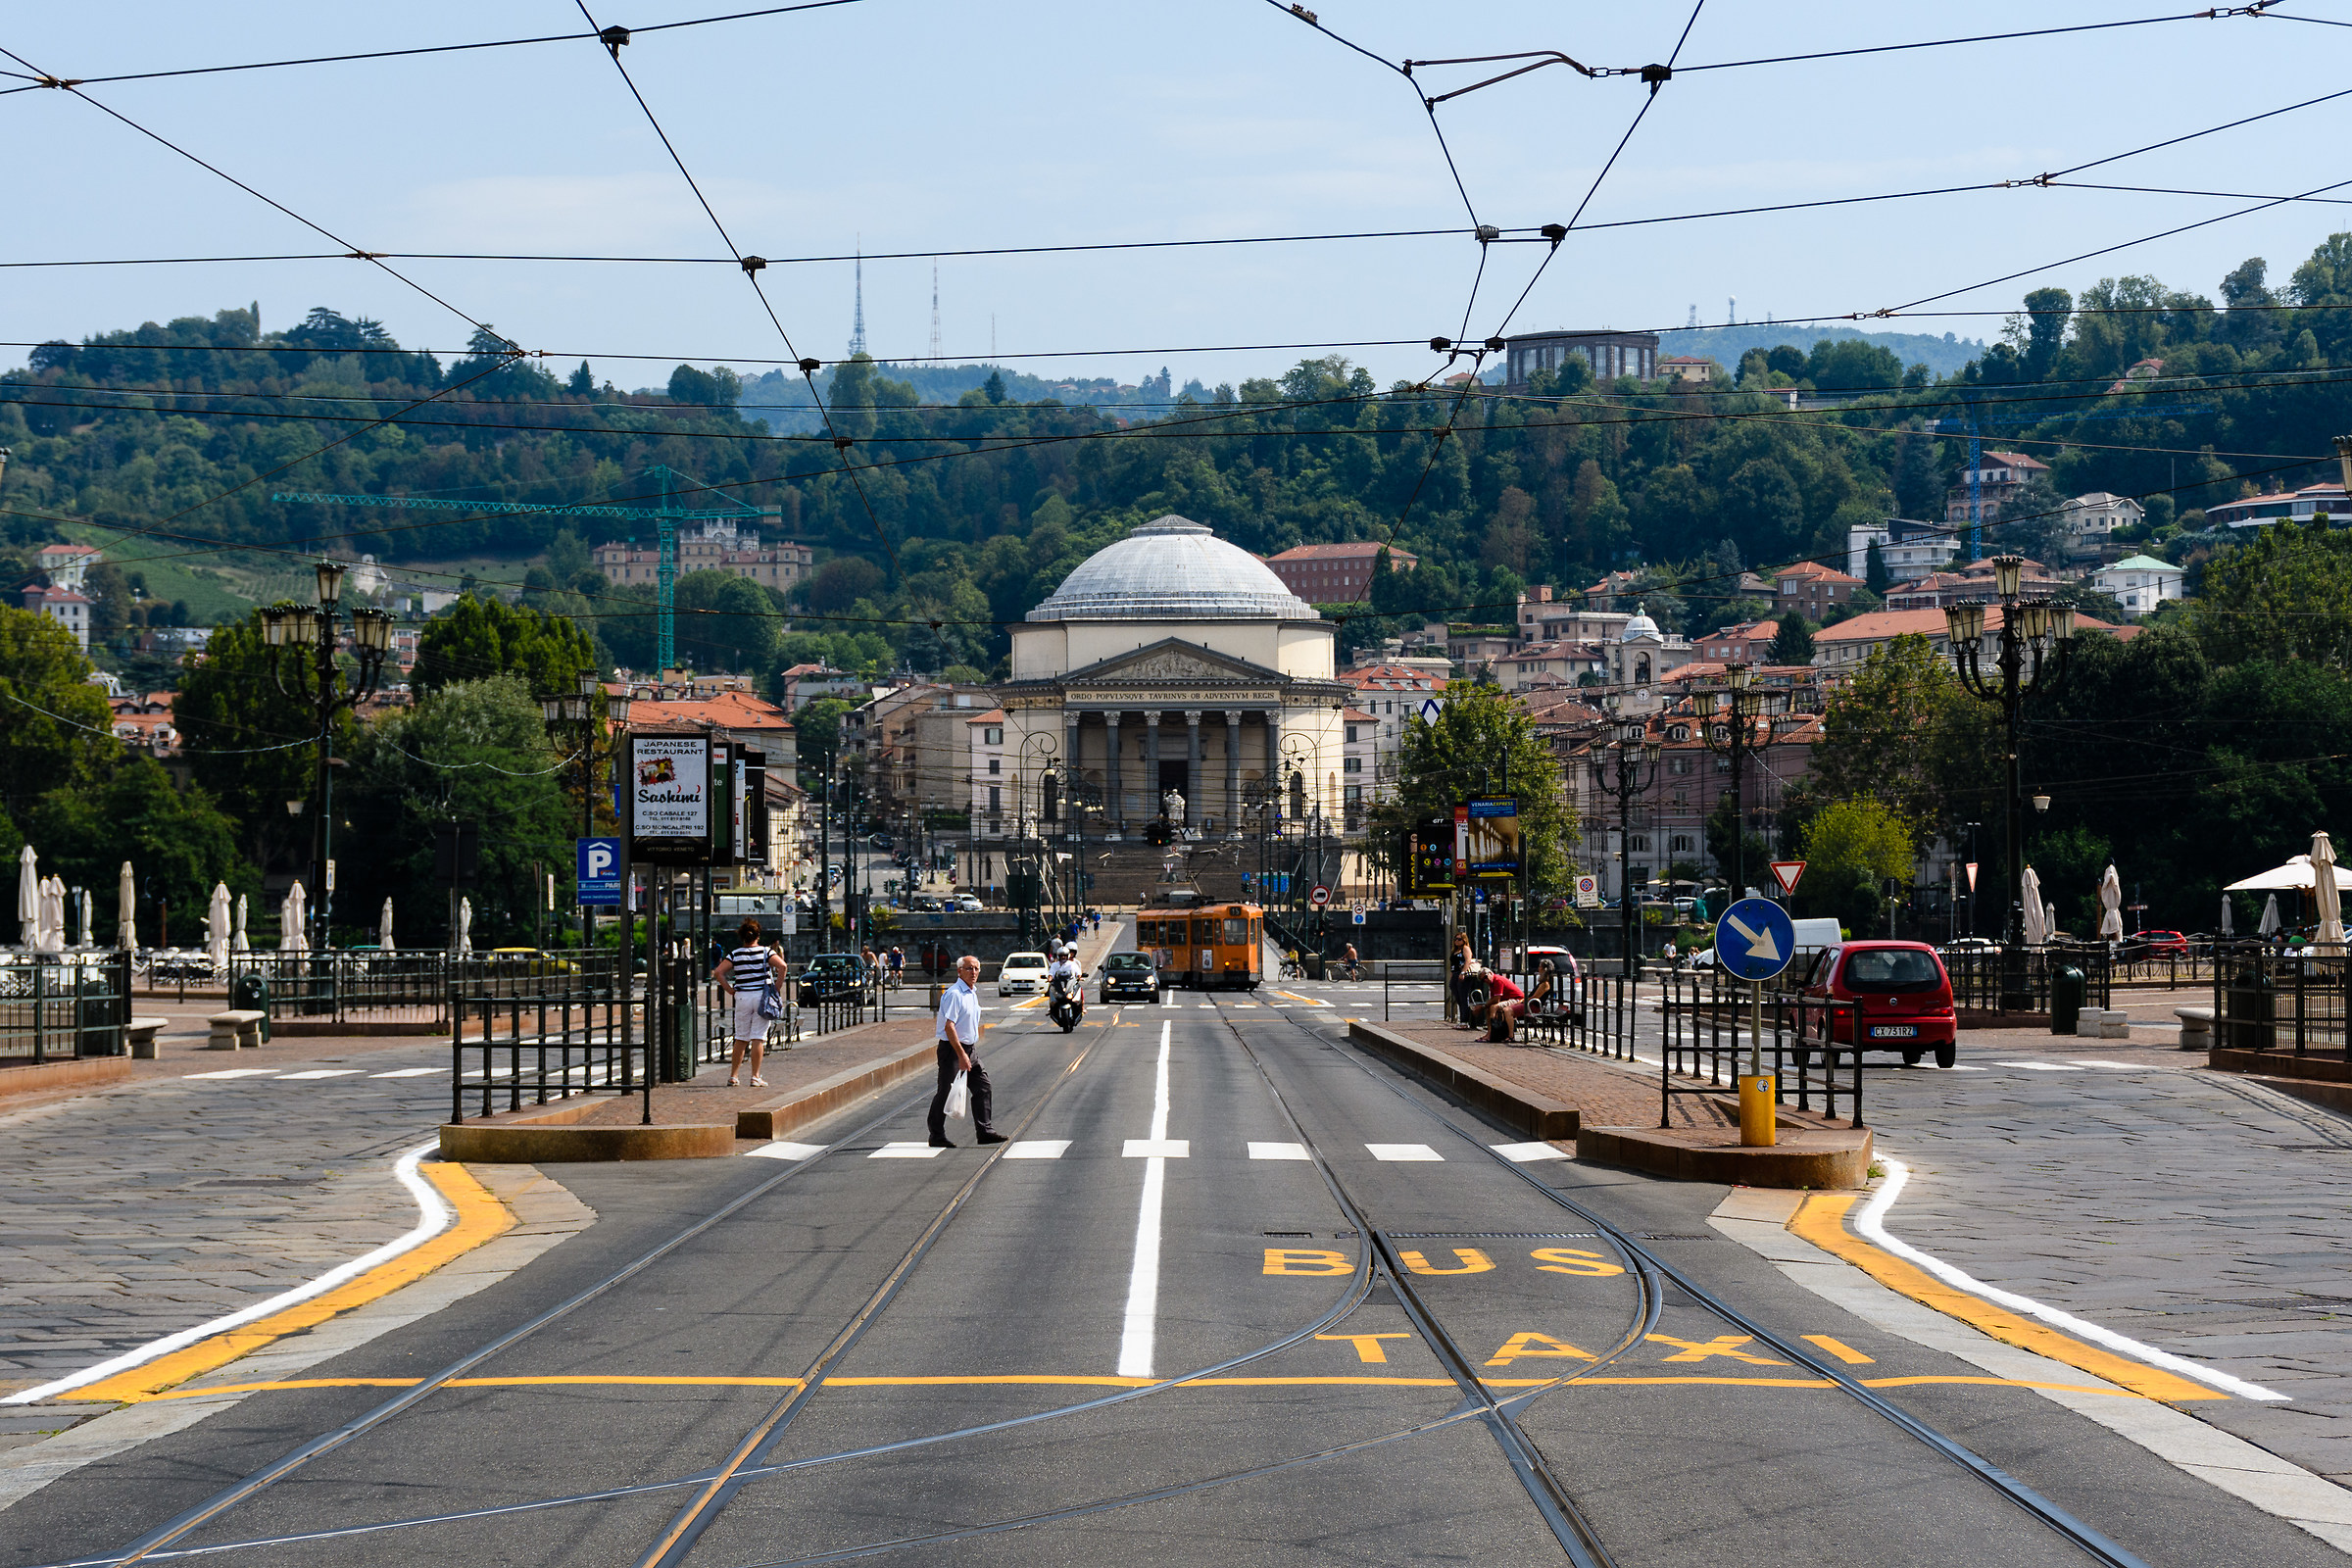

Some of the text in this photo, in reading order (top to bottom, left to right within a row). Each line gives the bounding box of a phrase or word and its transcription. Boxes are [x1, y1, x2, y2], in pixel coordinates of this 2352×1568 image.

[638, 784, 701, 803] Sashimi
[588, 850, 612, 878] P
[1262, 1248, 1625, 1276] BUS
[1314, 1332, 1876, 1366] TAXI
